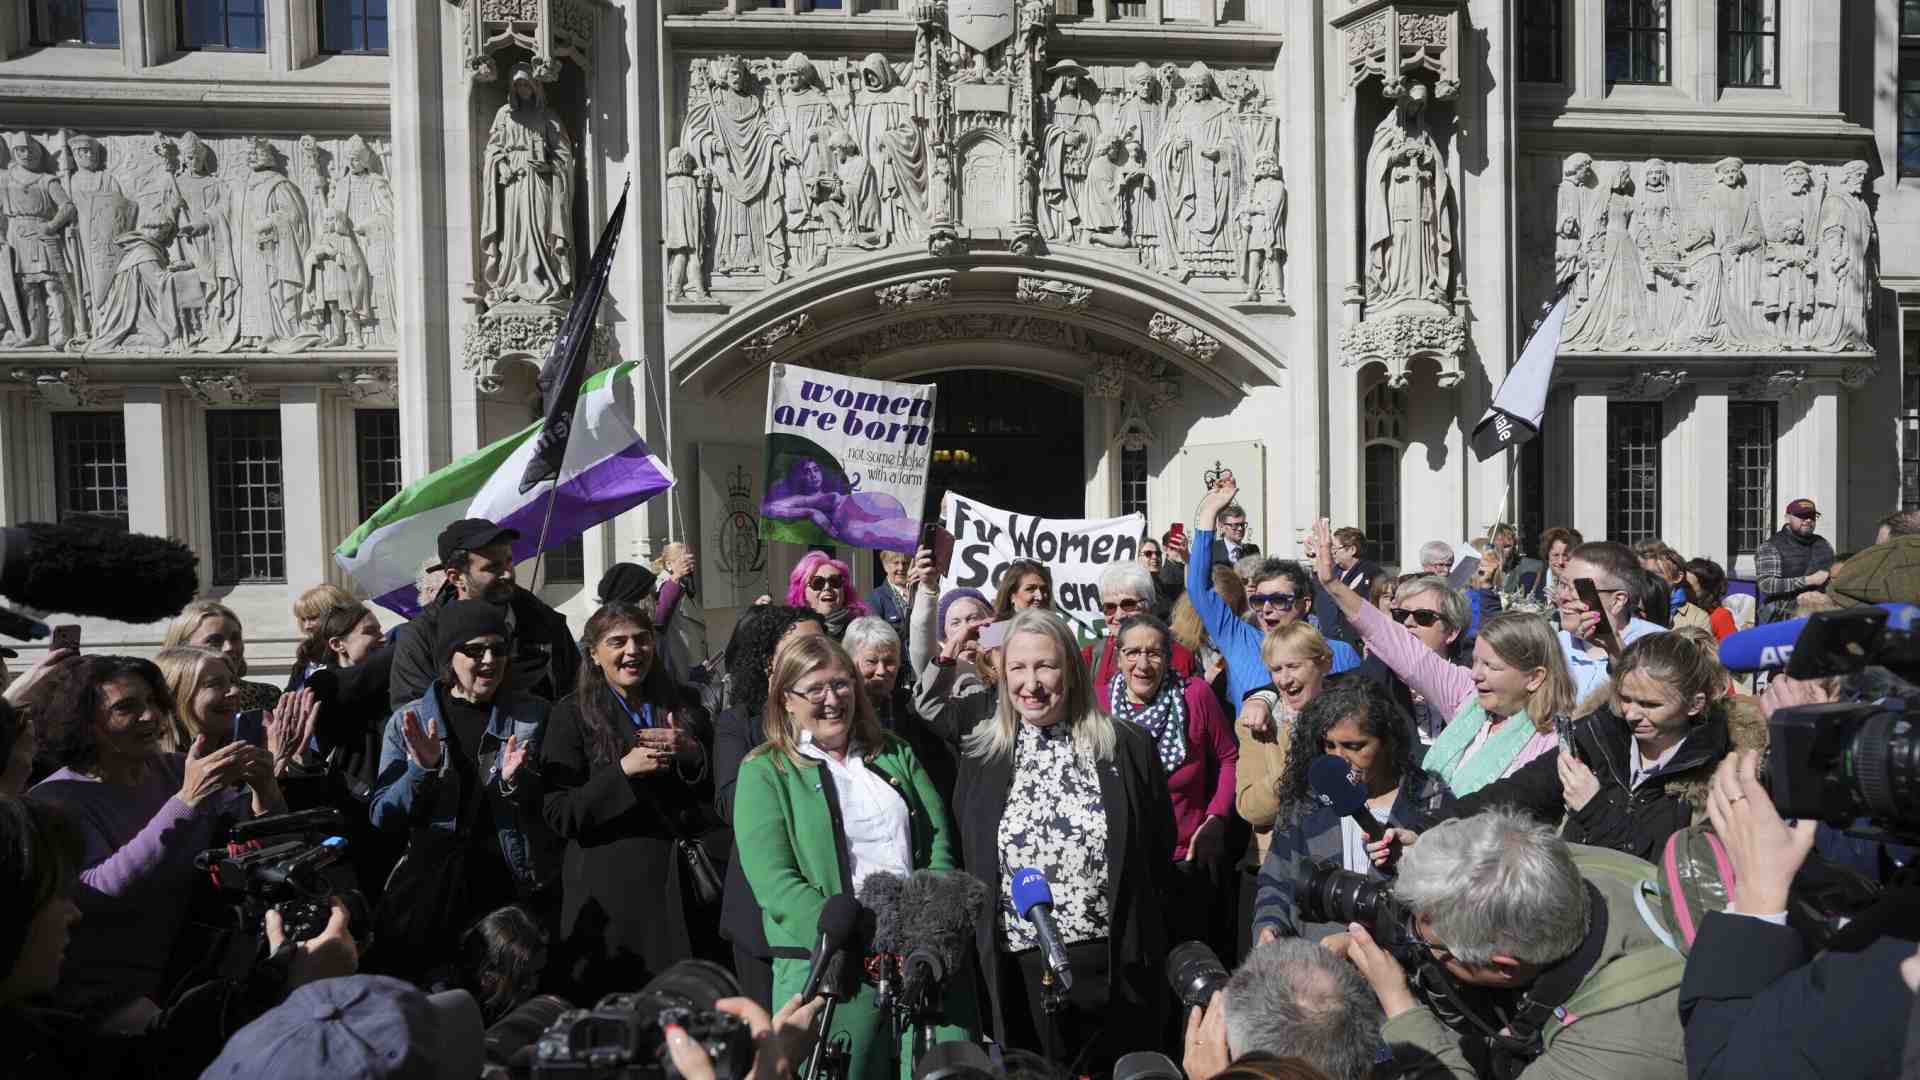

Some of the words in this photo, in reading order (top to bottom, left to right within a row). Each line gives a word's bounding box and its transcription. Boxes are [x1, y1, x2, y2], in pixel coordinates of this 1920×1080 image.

[800, 380, 933, 419] women
[774, 404, 837, 431] are
[843, 410, 929, 446] born
[848, 447, 865, 461] not
[867, 450, 895, 465] some
[897, 448, 927, 470] bloke
[867, 464, 887, 482] with
[889, 471, 897, 484] a
[898, 470, 923, 486] form
[1008, 514, 1136, 564] Women
